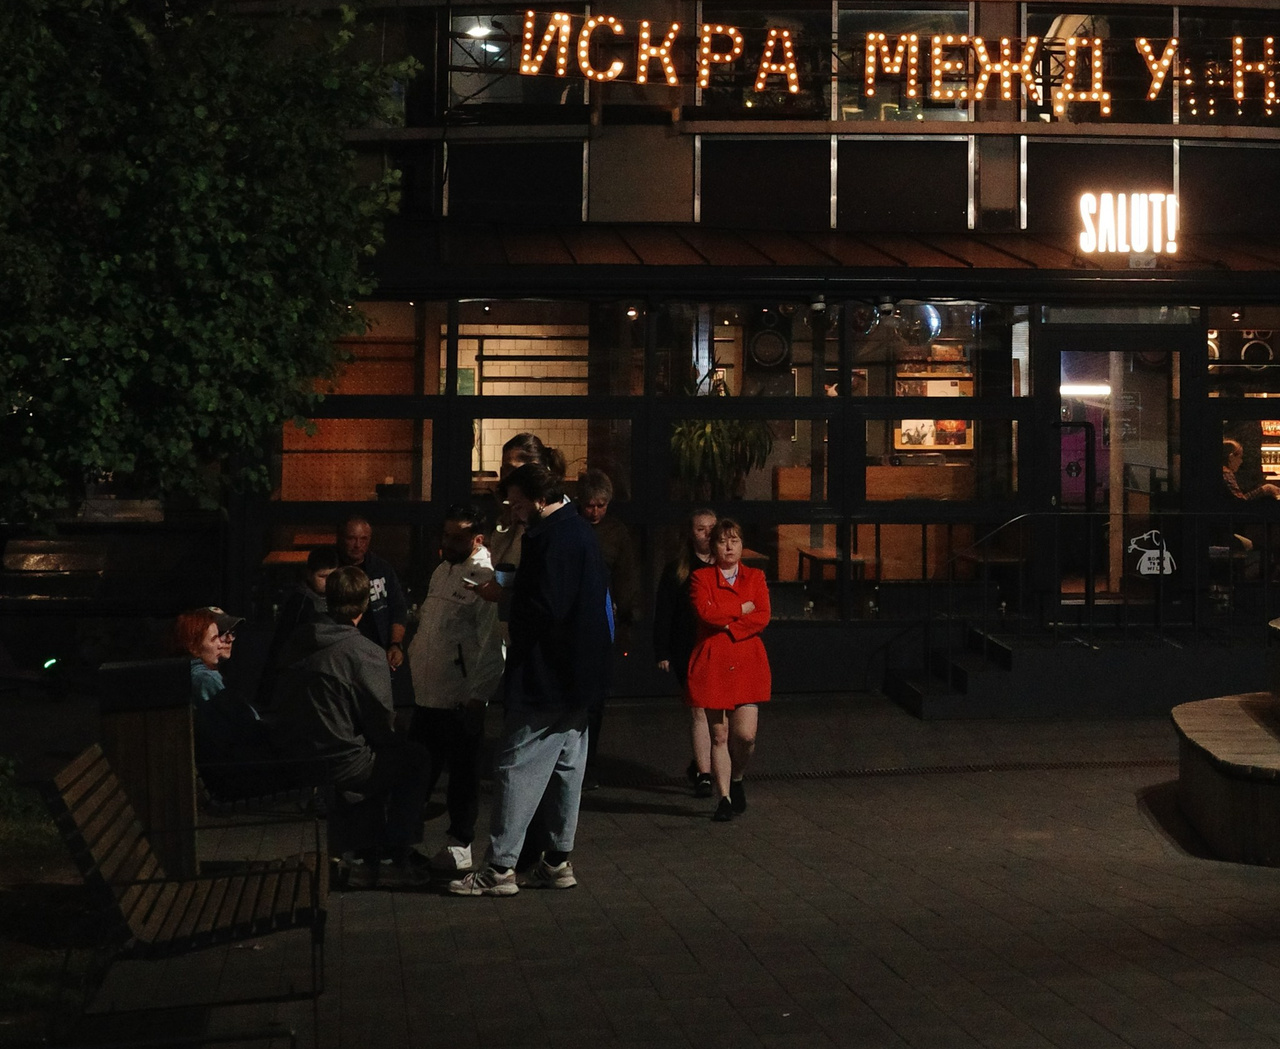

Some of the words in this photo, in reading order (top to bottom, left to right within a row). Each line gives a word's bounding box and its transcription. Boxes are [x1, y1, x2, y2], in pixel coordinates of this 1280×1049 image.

[519, 9, 799, 94] ИСКРА
[864, 31, 1179, 117] МЕЖДУ
[1080, 193, 1177, 253] SALUT!
